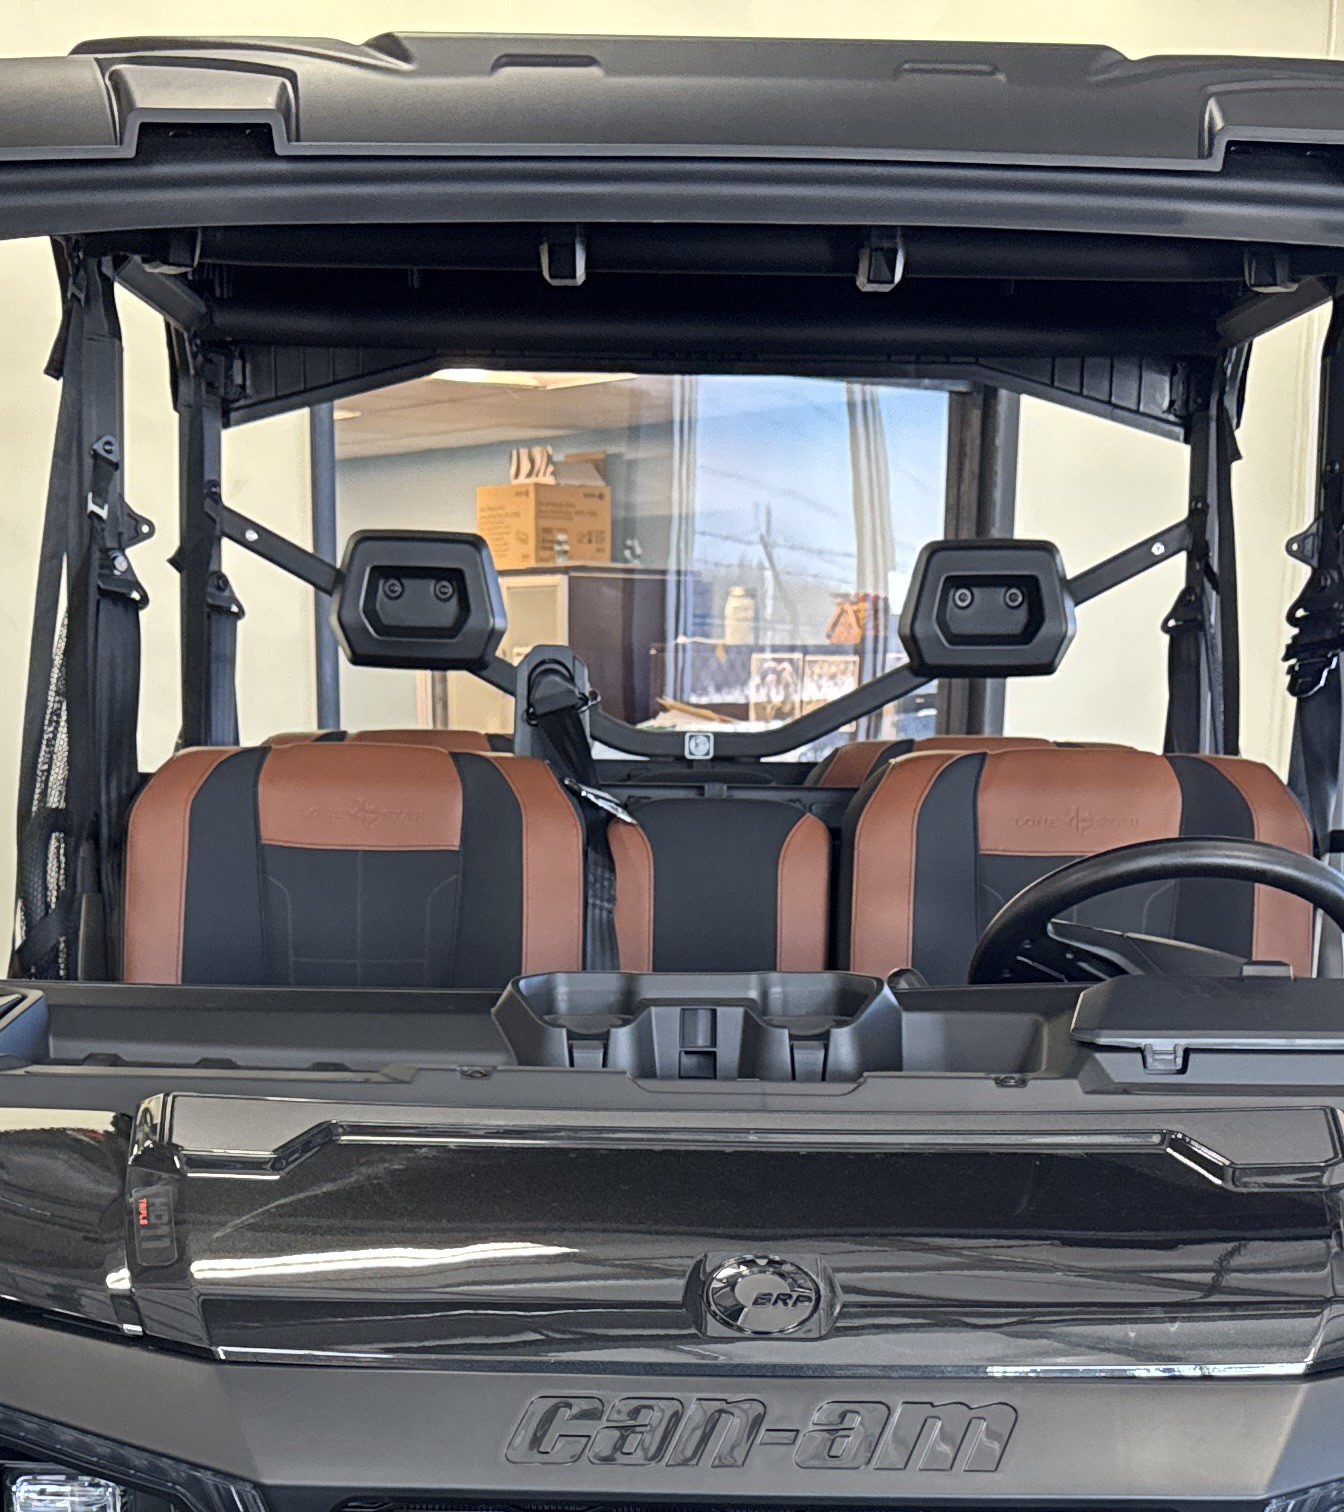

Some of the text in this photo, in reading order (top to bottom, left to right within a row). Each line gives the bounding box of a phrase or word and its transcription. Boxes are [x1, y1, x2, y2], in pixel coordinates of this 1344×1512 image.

[138, 1196, 149, 1226] TRIPLE
[752, 1292, 813, 1308] BRP
[504, 1395, 1018, 1472] can-am
